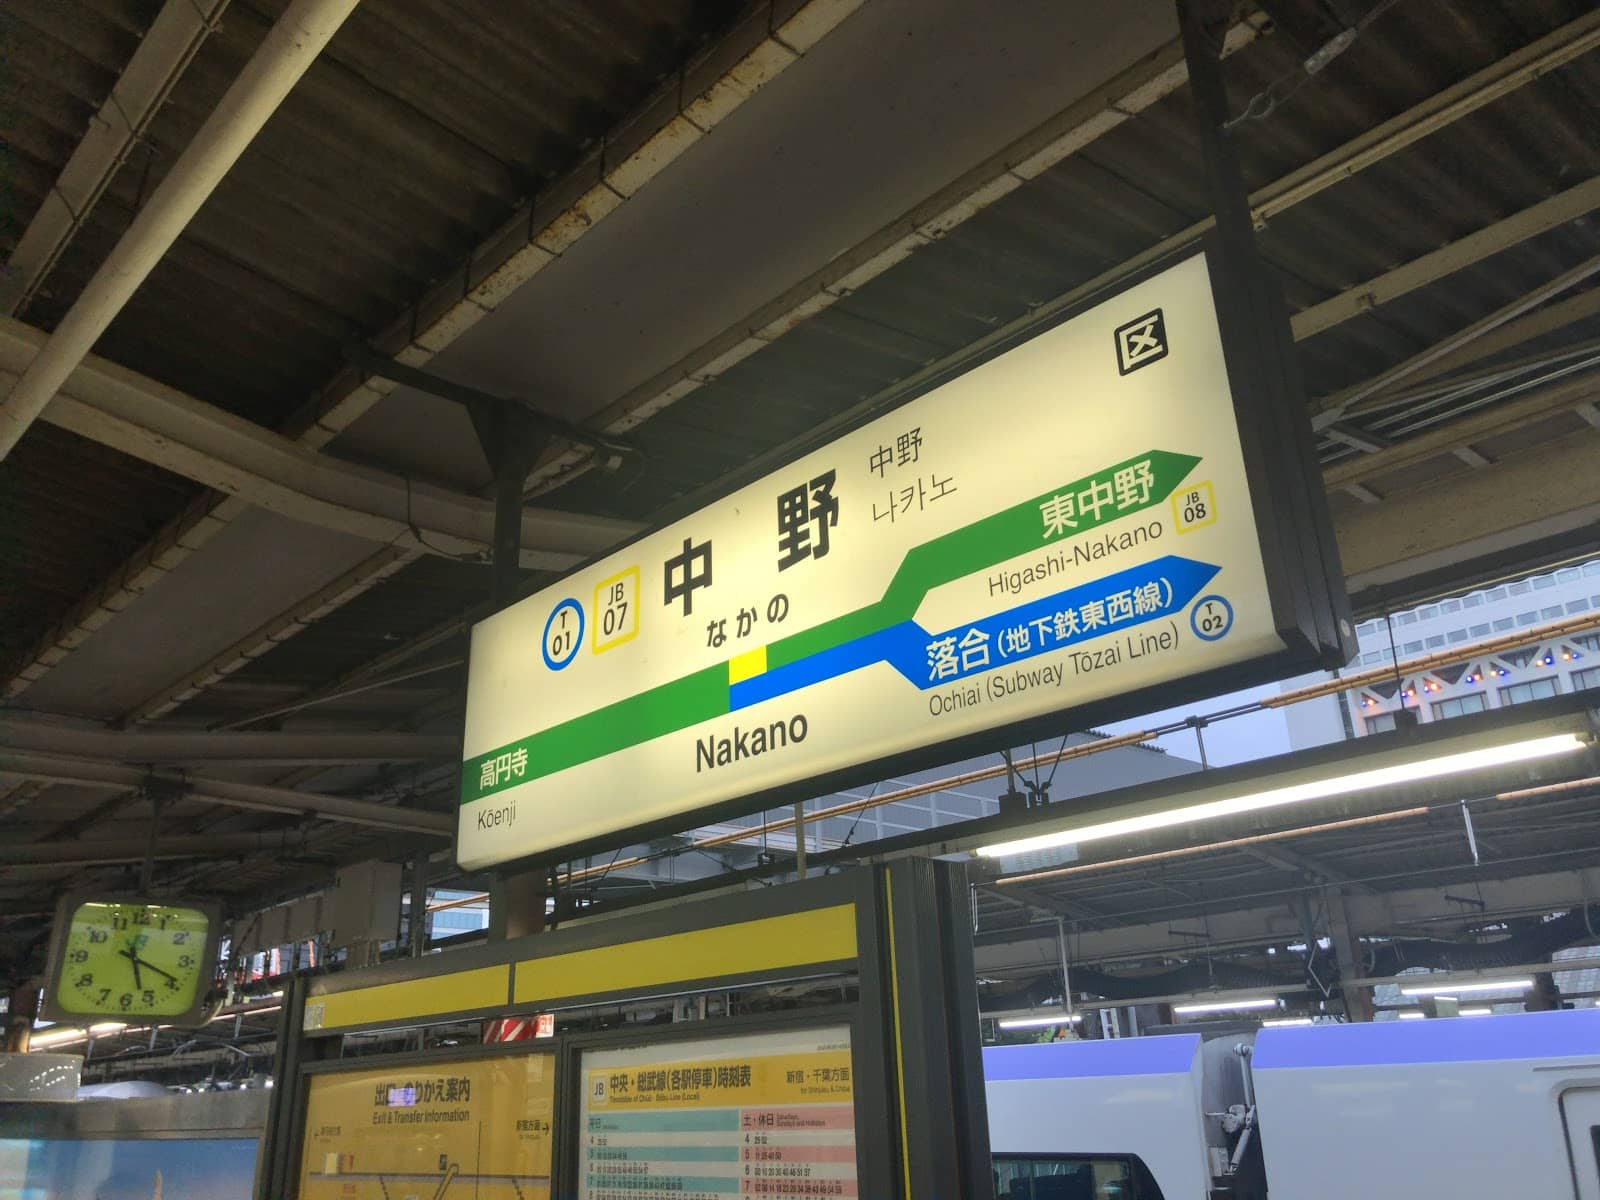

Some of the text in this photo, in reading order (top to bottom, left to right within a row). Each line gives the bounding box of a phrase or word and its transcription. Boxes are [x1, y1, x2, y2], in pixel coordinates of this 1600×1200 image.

[1118, 312, 1164, 372] 区
[869, 426, 923, 479] 中野
[872, 473, 958, 524] 나카노
[1039, 459, 1155, 539] 東中野
[1185, 490, 1200, 507] JB
[1183, 503, 1207, 525] 08
[988, 519, 1164, 598] Higashi-Nakano
[607, 582, 625, 606] JB
[1204, 601, 1213, 616] T
[559, 610, 569, 630] T
[602, 602, 629, 637] 07
[705, 593, 790, 649] なかの
[1201, 613, 1223, 633] 02
[552, 629, 572, 656] 01
[929, 620, 1179, 717] Ochiai (Subway Tōzai Line)
[695, 713, 809, 773] Nakano
[479, 747, 529, 791] 高円寺
[477, 799, 517, 832] Kōenji
[111, 916, 128, 930] 11
[132, 911, 150, 925] 12
[88, 930, 108, 944] 10
[173, 932, 186, 945] 2
[75, 949, 89, 963] 9
[178, 954, 190, 968] 3
[80, 973, 93, 987] 8
[99, 988, 112, 1001] 7
[119, 993, 133, 1007] 6
[142, 990, 155, 1003] 5
